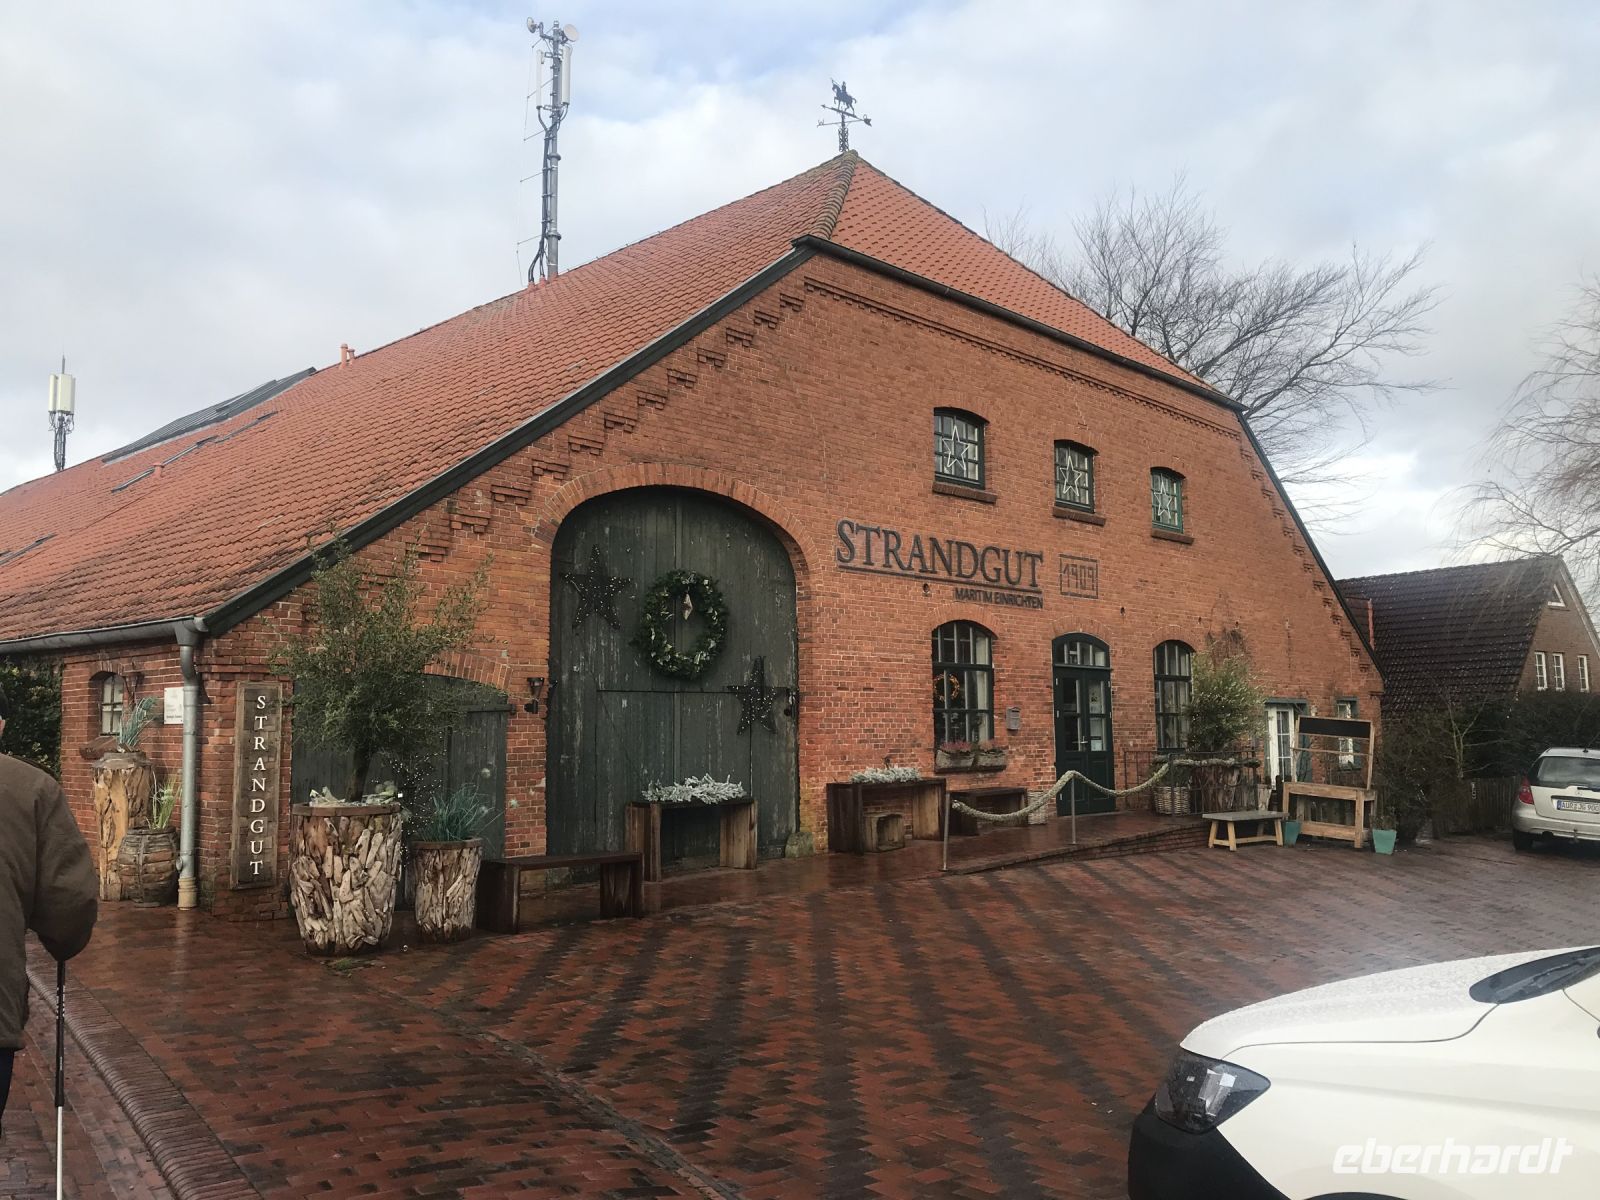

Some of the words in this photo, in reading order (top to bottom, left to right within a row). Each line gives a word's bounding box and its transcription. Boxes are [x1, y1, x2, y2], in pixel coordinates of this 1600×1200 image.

[837, 519, 1043, 588] STRANDGUT
[1063, 563, 1095, 591] 1909
[954, 587, 992, 604] MARITIM
[993, 591, 1043, 609] EINRICHTEN
[249, 695, 267, 875] STRANDGUT
